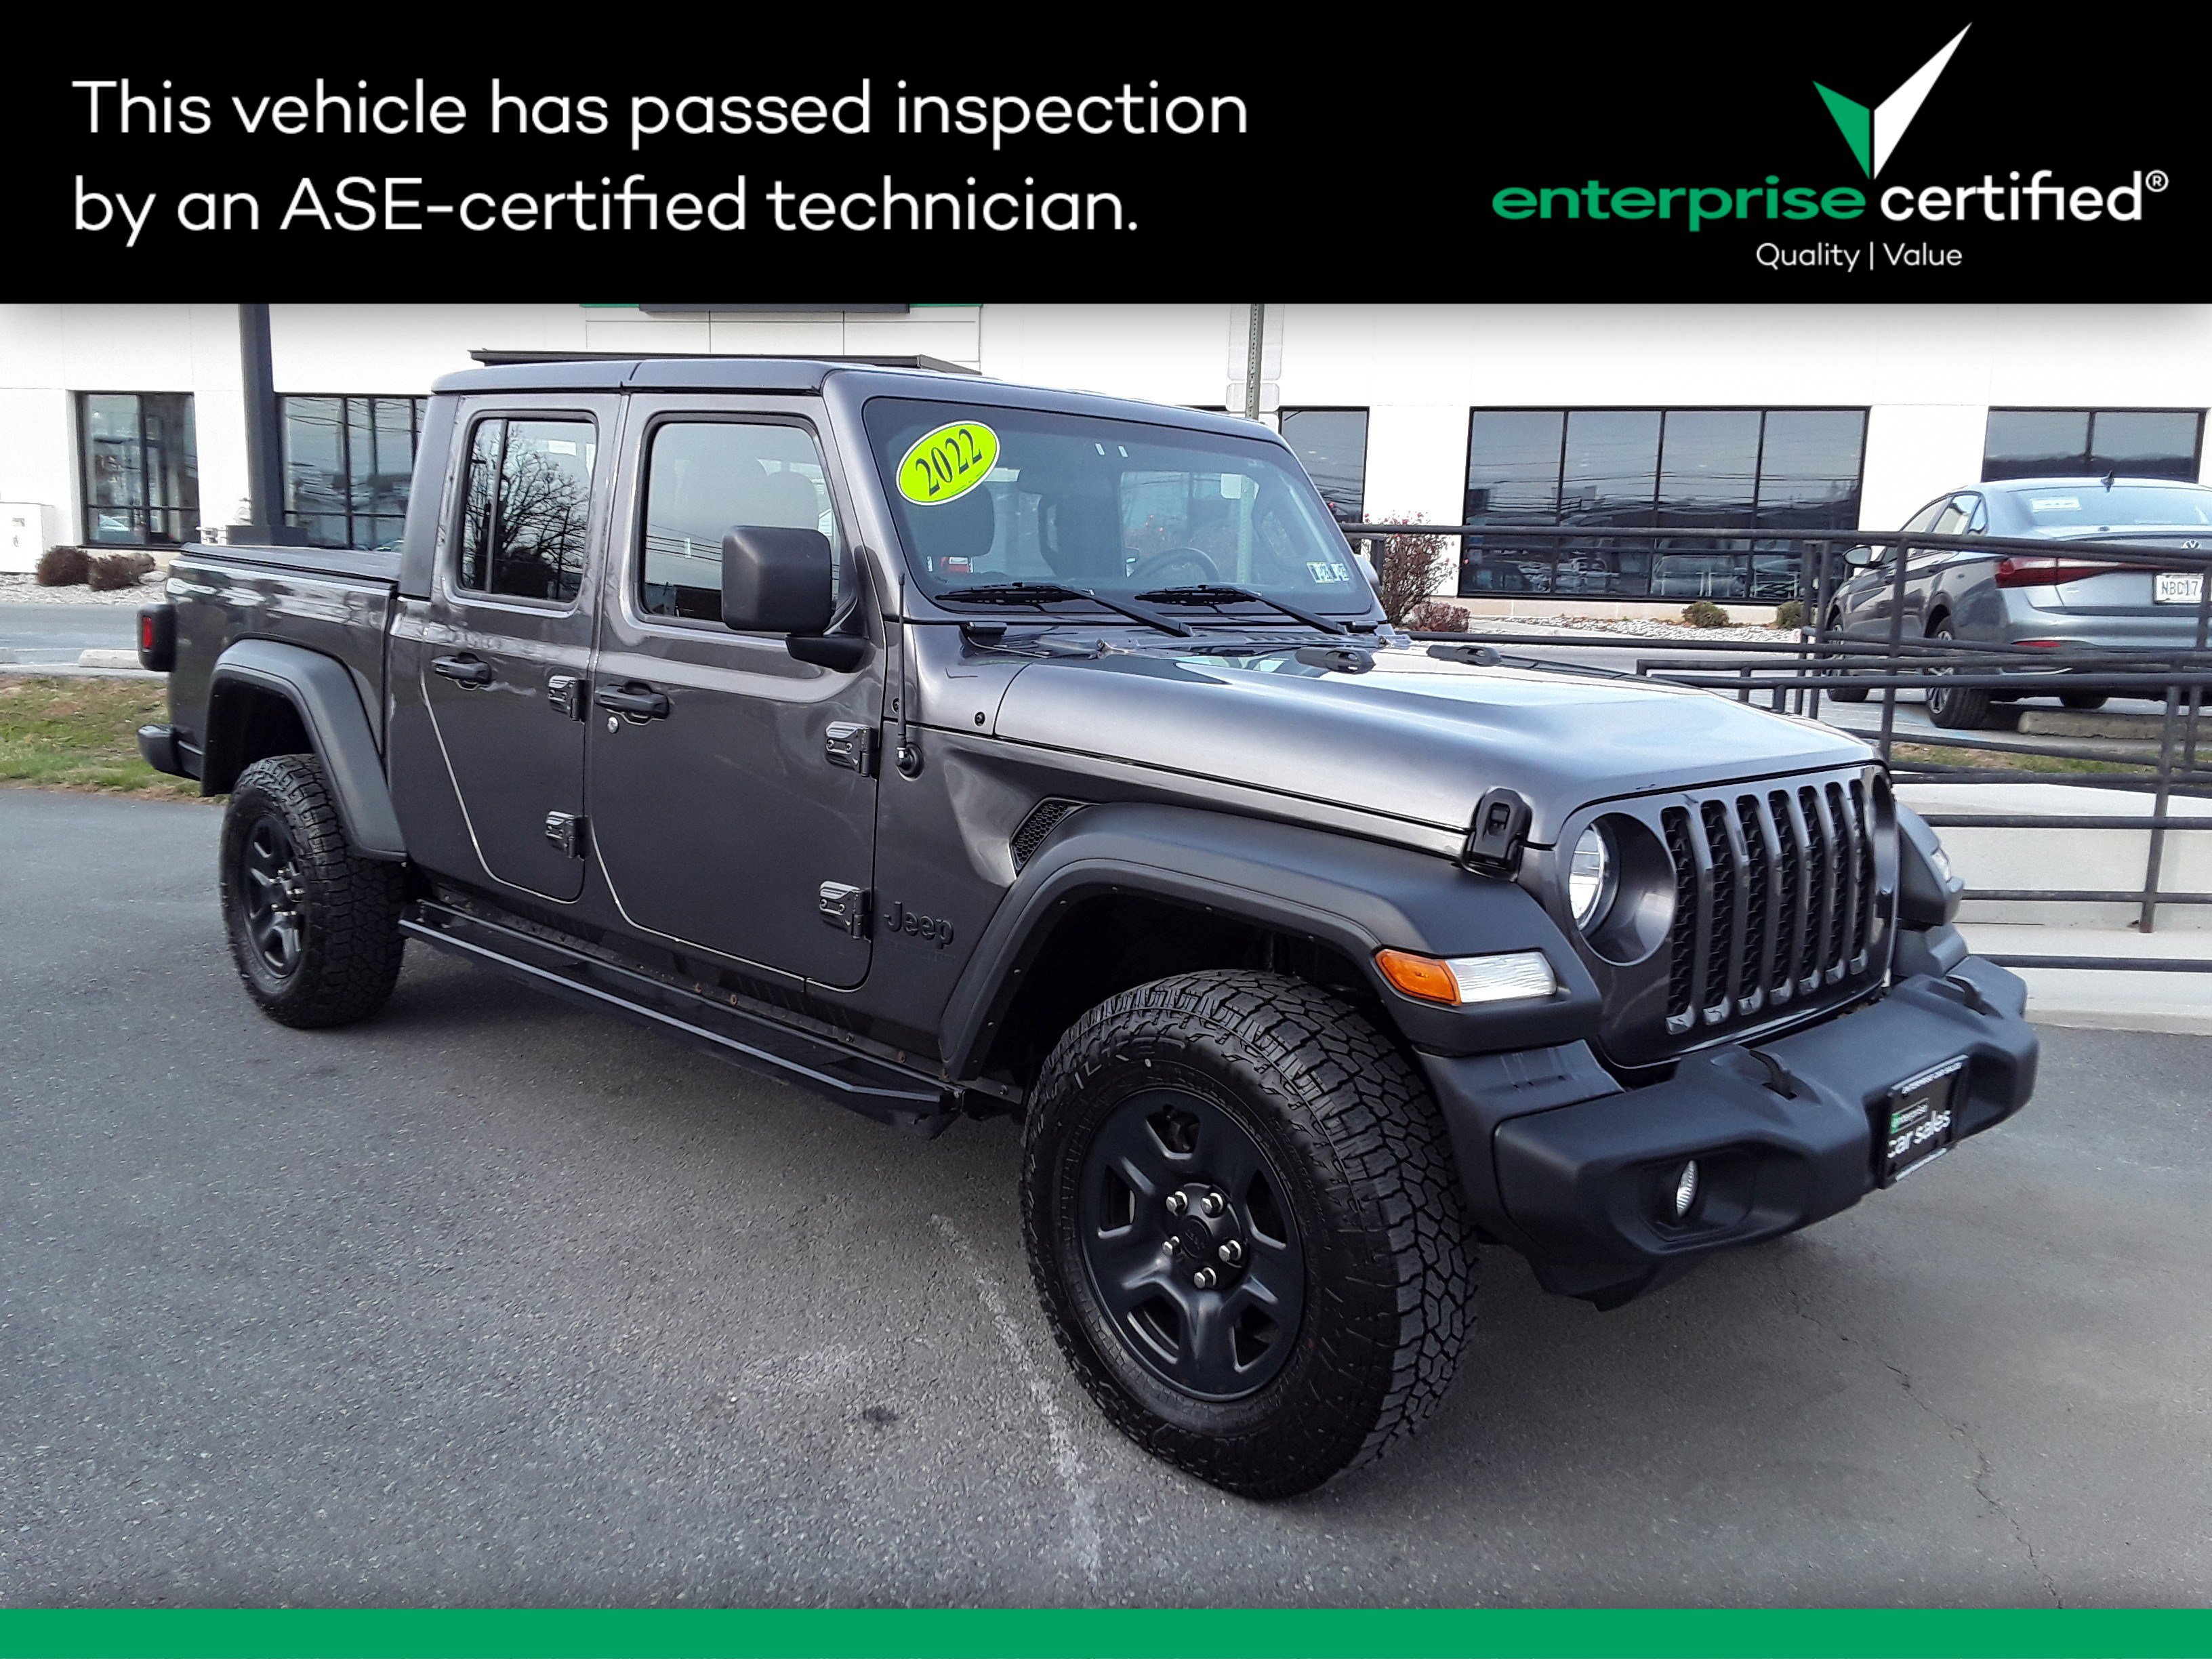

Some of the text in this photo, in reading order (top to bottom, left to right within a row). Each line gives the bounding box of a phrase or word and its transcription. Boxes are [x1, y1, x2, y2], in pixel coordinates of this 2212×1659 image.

[915, 428, 983, 497] 2022
[2161, 579, 2201, 596] NBC17
[883, 901, 954, 950] Jeep
[1912, 1110, 1952, 1145] sales
